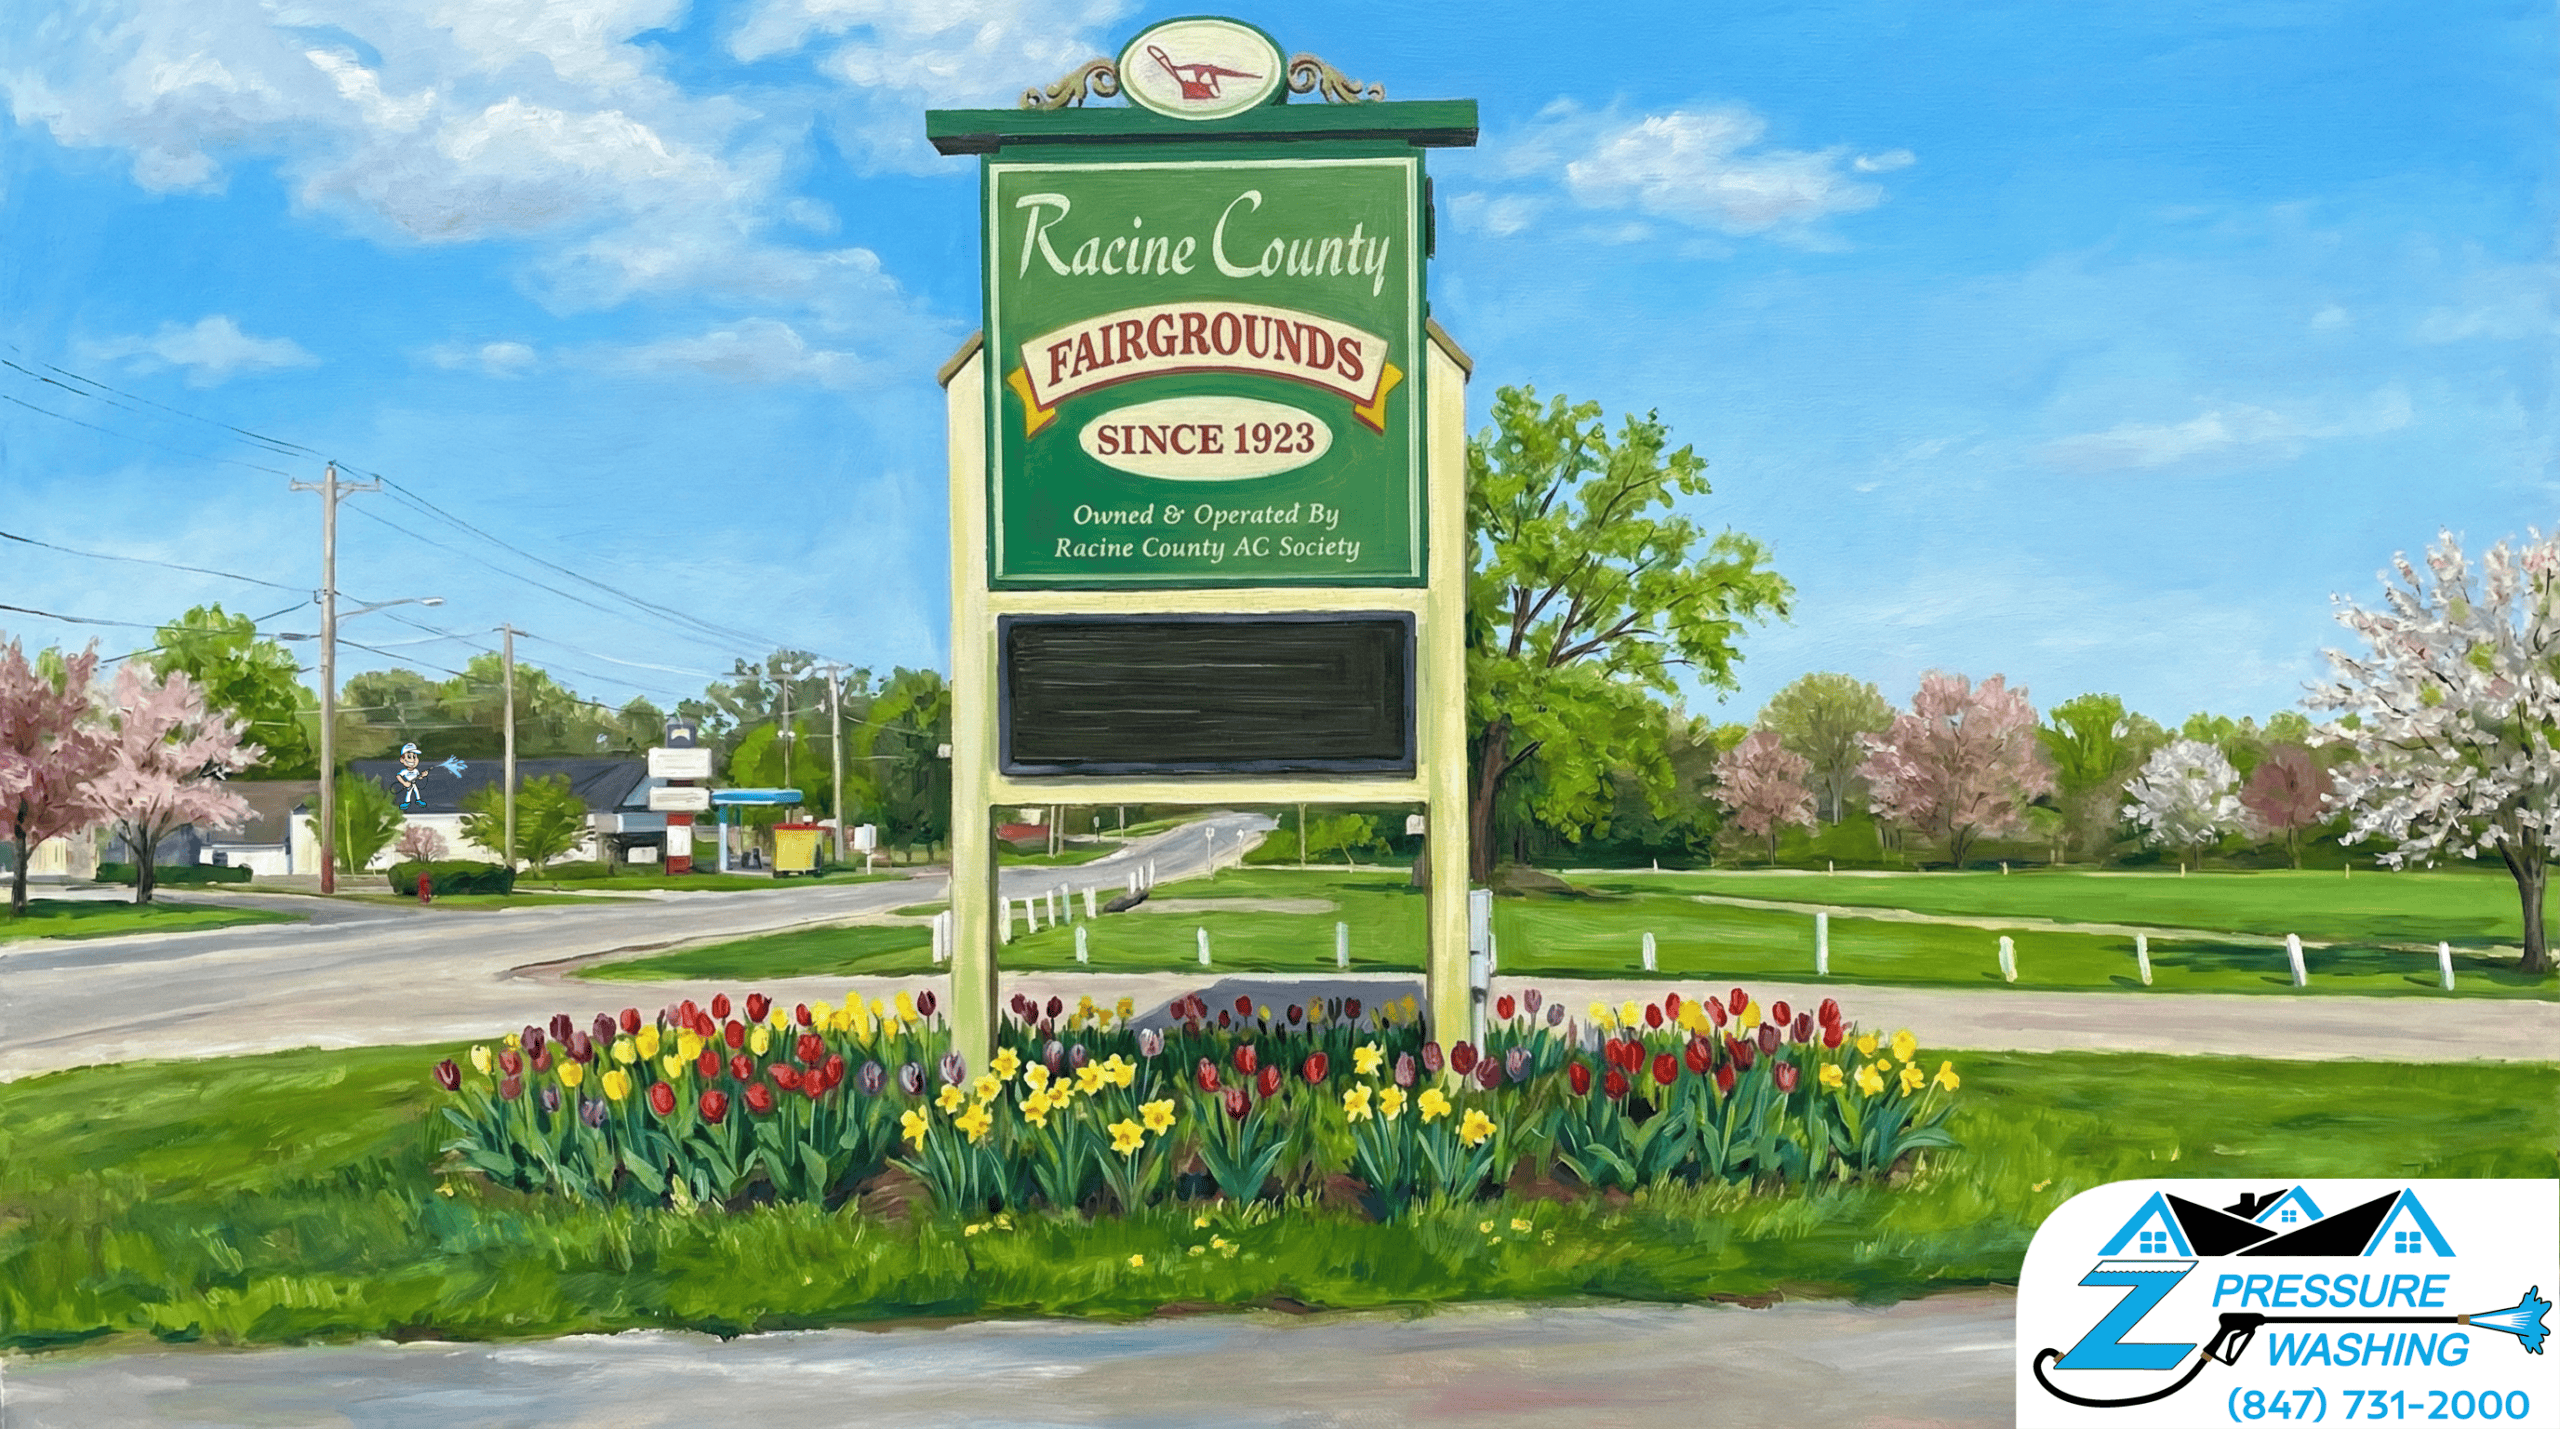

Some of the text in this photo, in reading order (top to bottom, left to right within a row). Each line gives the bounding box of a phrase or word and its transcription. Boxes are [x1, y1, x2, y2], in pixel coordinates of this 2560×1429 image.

[1015, 189, 1390, 297] Racine County
[1046, 312, 1363, 387] FAIRGROUNDS
[1097, 422, 1315, 456] SINCE 1923
[1073, 501, 1340, 531] Owned & Operated By
[1054, 535, 1361, 565] Racine County AC Society
